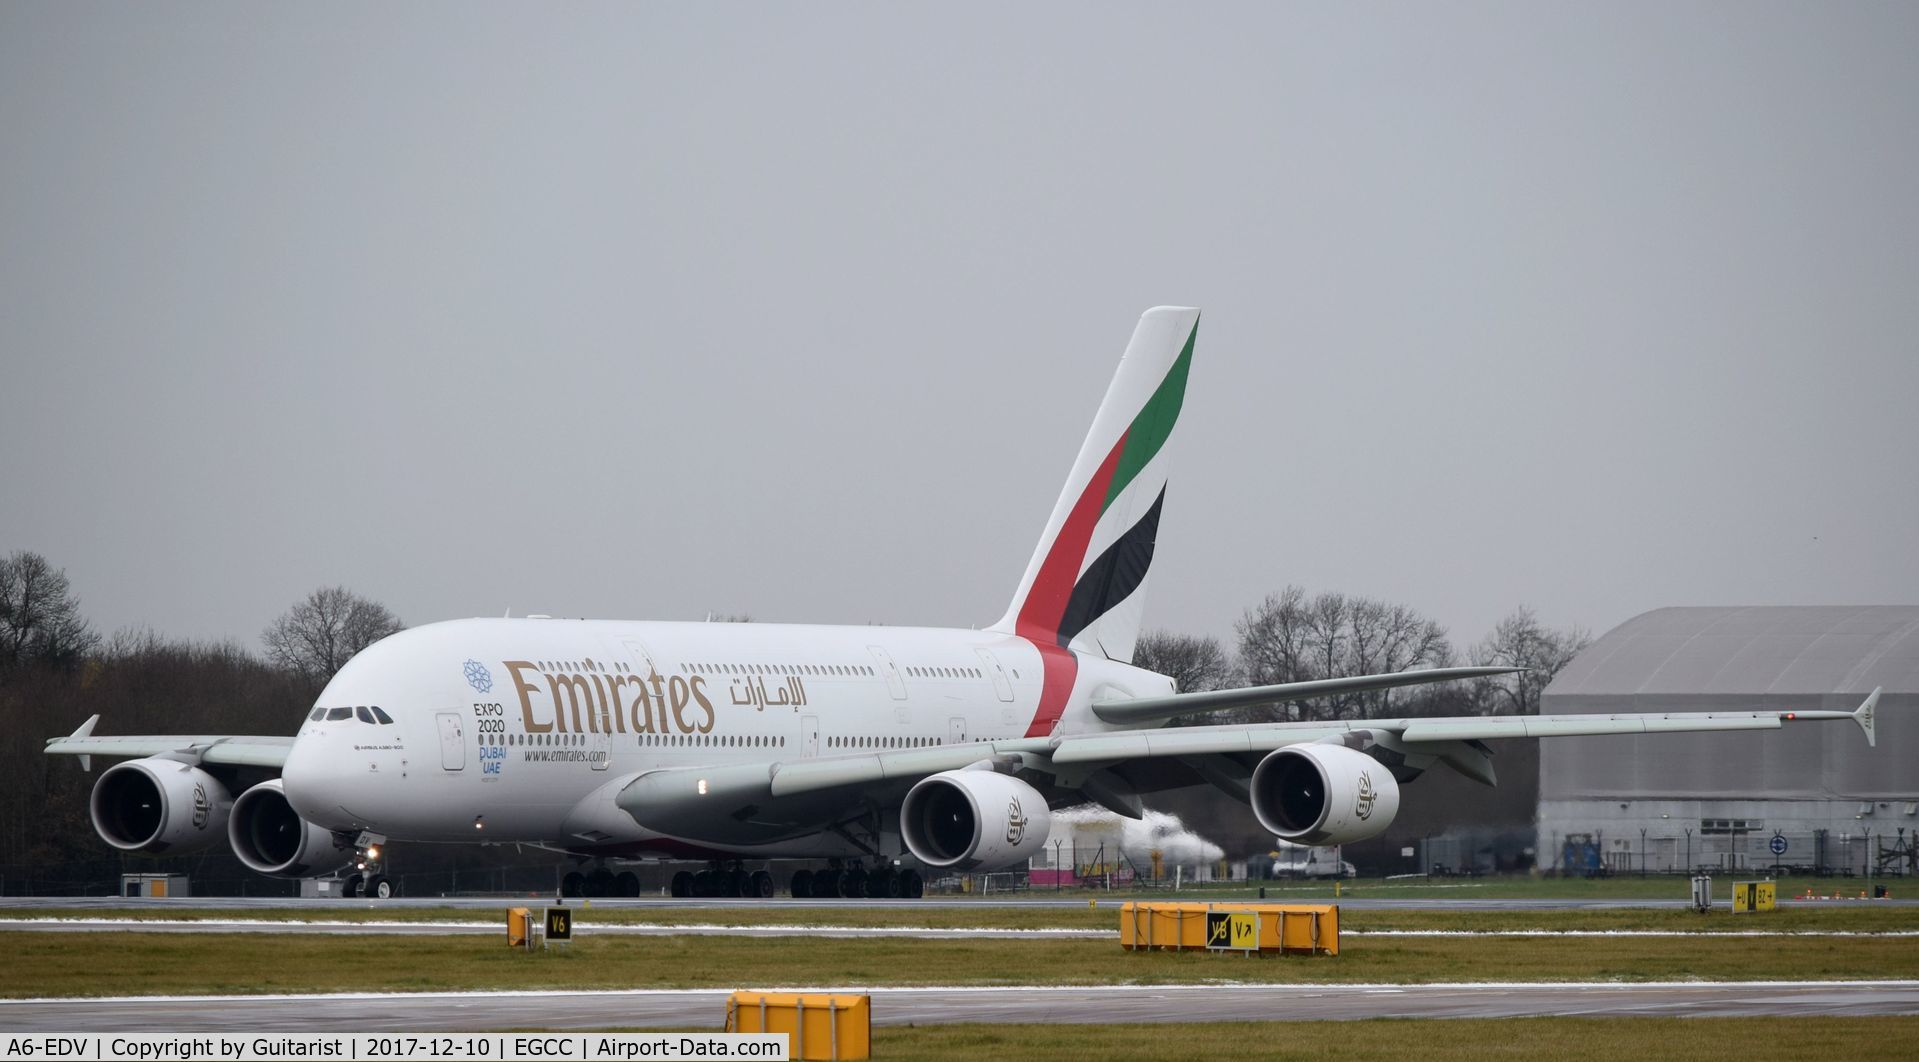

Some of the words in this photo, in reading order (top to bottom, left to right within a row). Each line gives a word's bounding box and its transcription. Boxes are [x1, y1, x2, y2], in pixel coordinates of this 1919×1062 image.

[502, 657, 715, 734] Emirates
[473, 703, 503, 716] EXPO
[478, 719, 505, 733] 2020
[480, 746, 507, 759] DUBAI
[524, 747, 607, 763] www.emirates.com
[483, 761, 501, 774] UAE
[552, 915, 565, 933] V6
[1235, 921, 1243, 940] V
